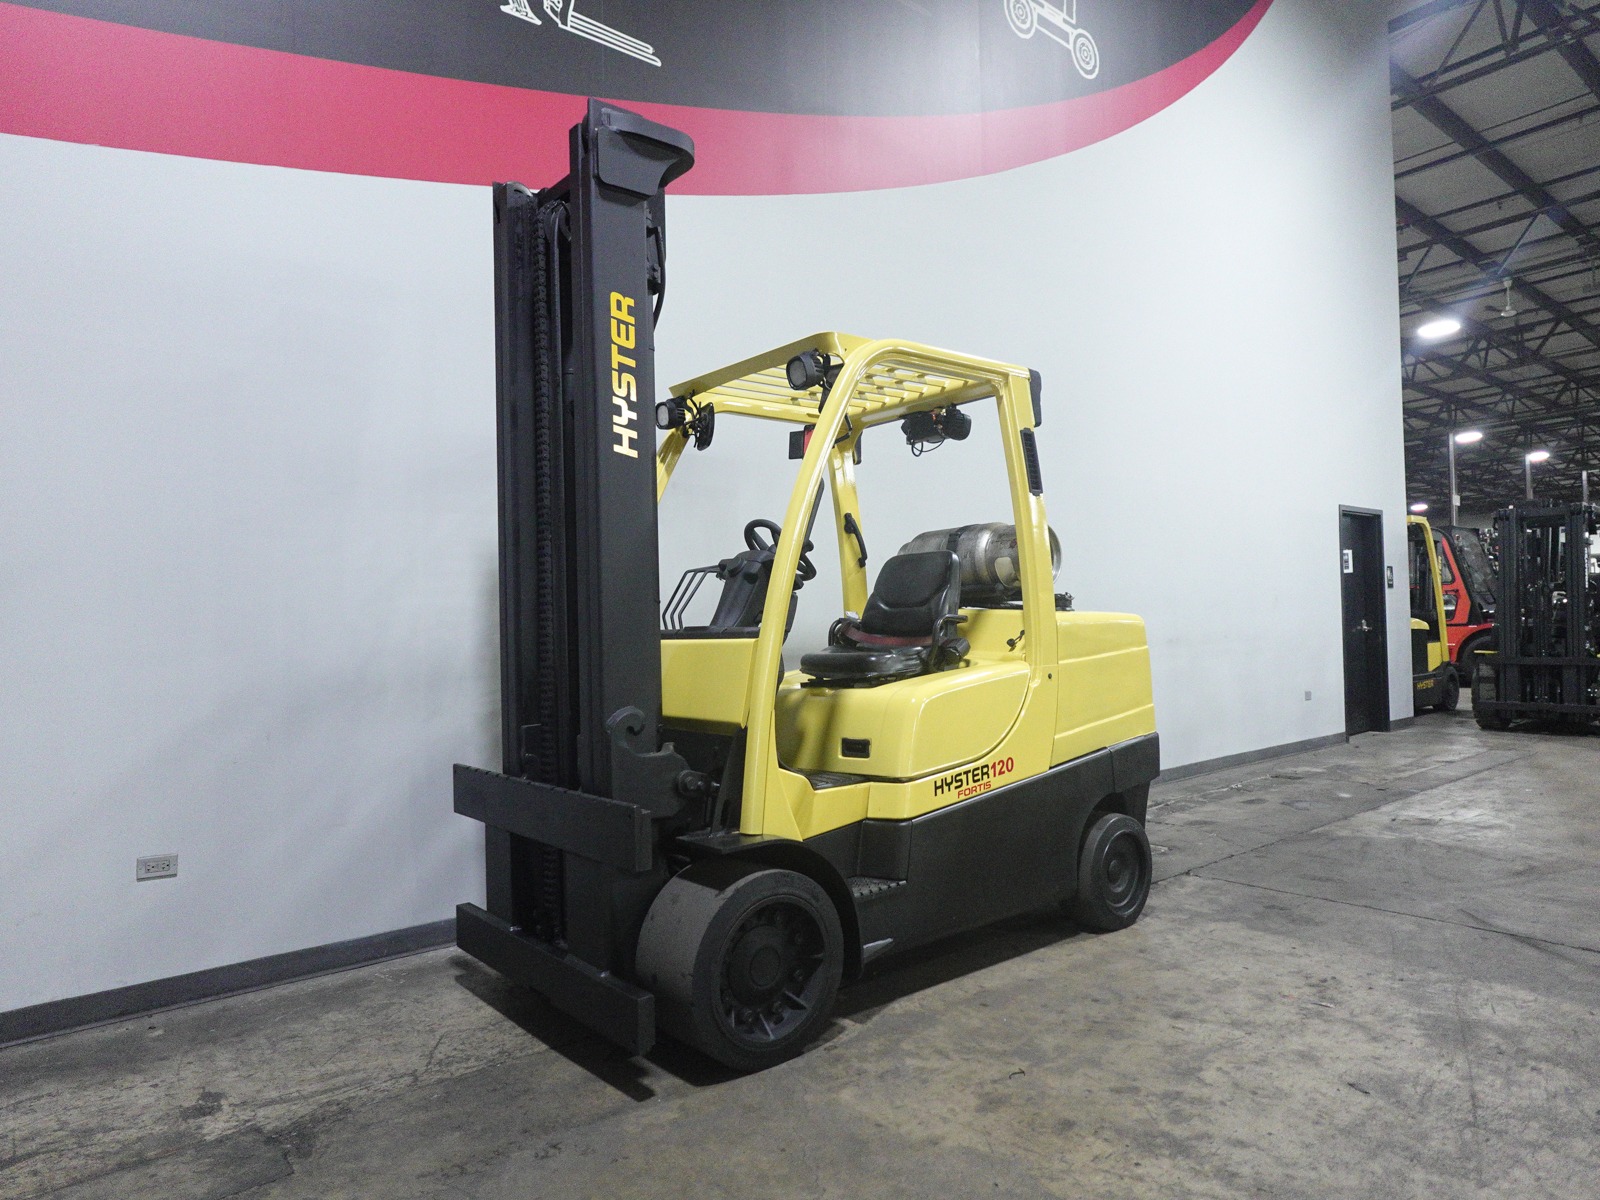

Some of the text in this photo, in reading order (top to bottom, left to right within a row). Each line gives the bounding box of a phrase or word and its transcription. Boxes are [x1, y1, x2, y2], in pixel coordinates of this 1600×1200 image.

[610, 291, 639, 458] HYSTER
[934, 756, 1014, 796] HYSTER 120
[957, 781, 992, 799] FORTIS
